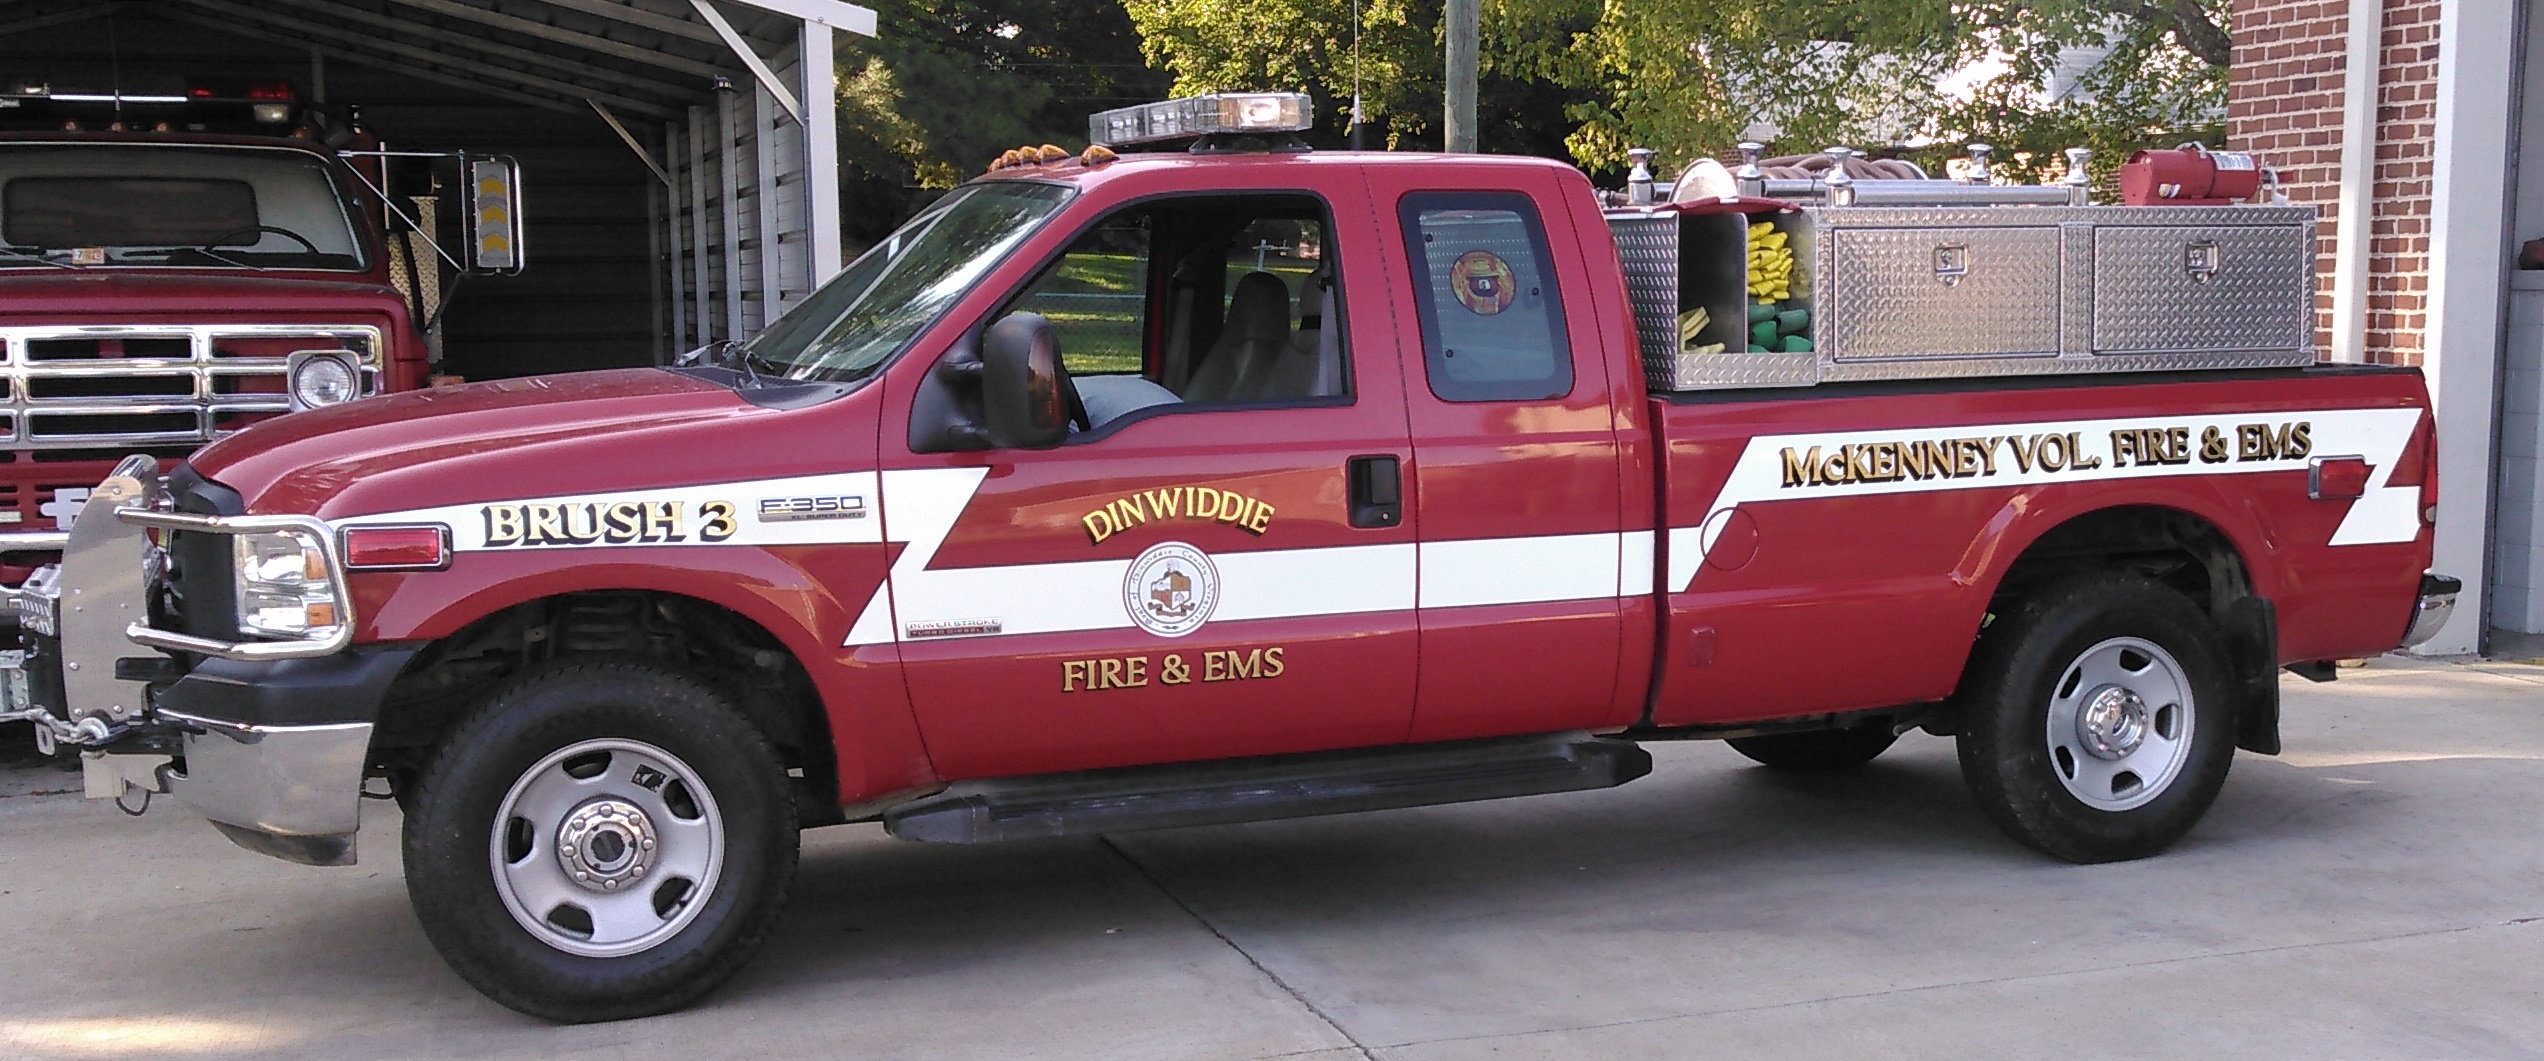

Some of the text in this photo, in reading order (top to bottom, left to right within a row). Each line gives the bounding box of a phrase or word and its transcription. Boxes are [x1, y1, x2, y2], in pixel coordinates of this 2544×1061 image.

[1780, 422, 2313, 488] McKENNEY VOL. FIRE & EMS
[480, 500, 738, 548] BRUSH 3
[1081, 487, 1276, 546] DINWIDDIE
[1062, 648, 1285, 692] FIRE & EMS
